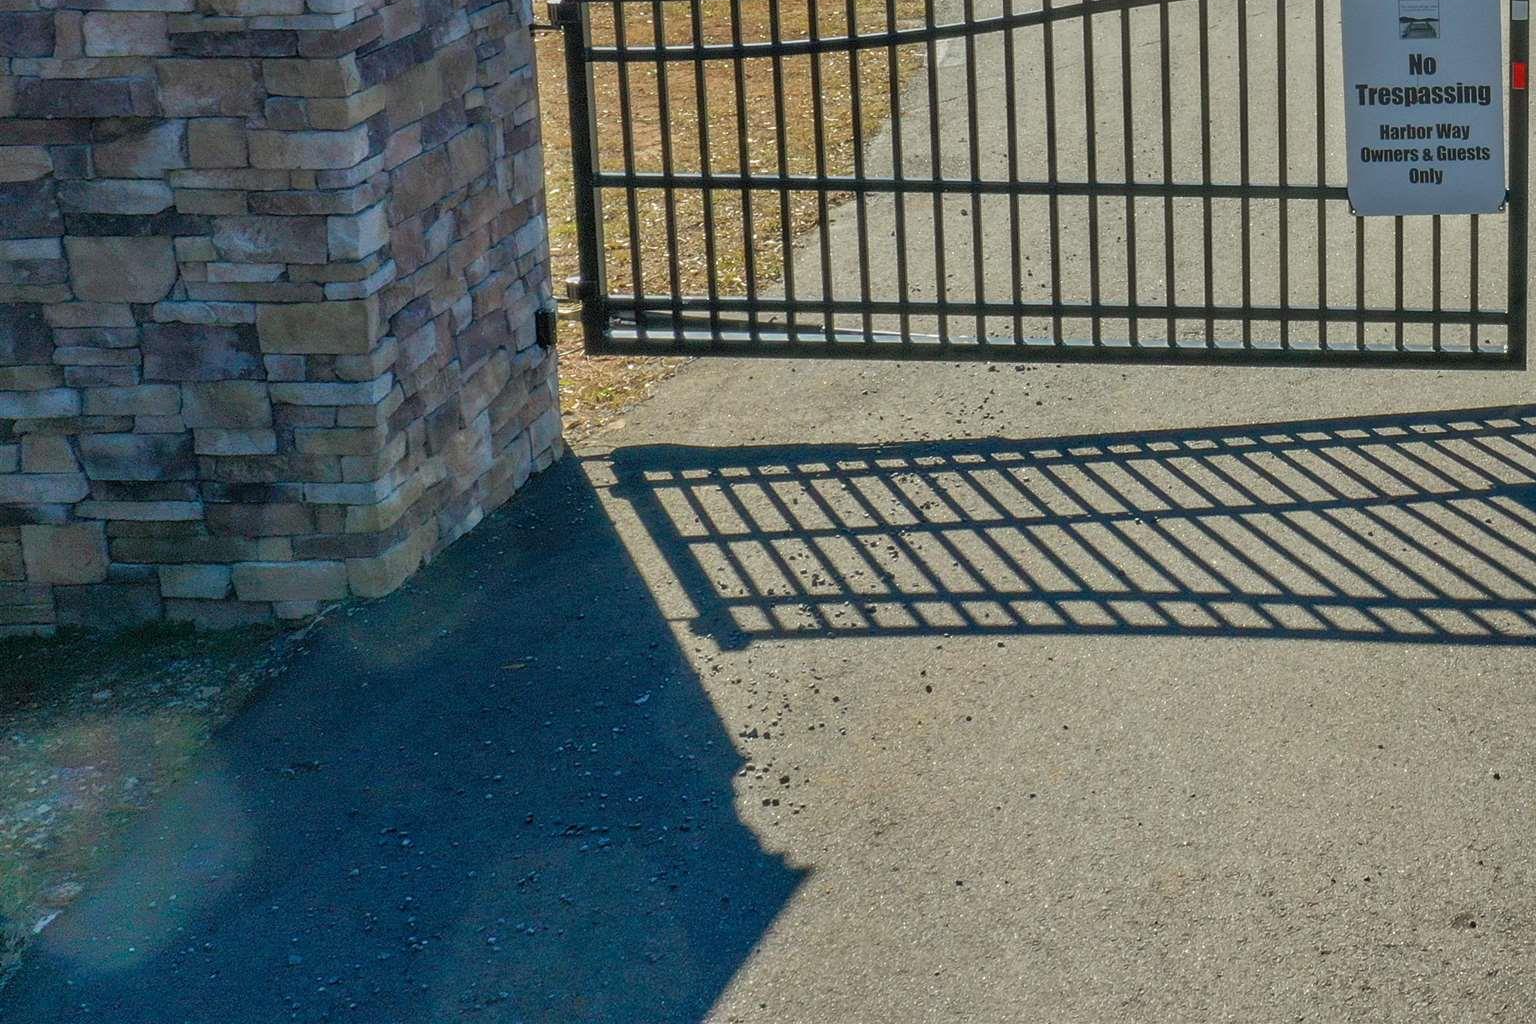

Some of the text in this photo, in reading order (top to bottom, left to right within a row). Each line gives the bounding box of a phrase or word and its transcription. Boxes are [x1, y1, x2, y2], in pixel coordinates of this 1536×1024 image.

[1408, 54, 1436, 75] No
[1355, 83, 1491, 107] Trespassing
[1380, 123, 1470, 140] Harbor Way
[1360, 145, 1491, 163] Owners & Guests
[1408, 168, 1443, 185] Only
